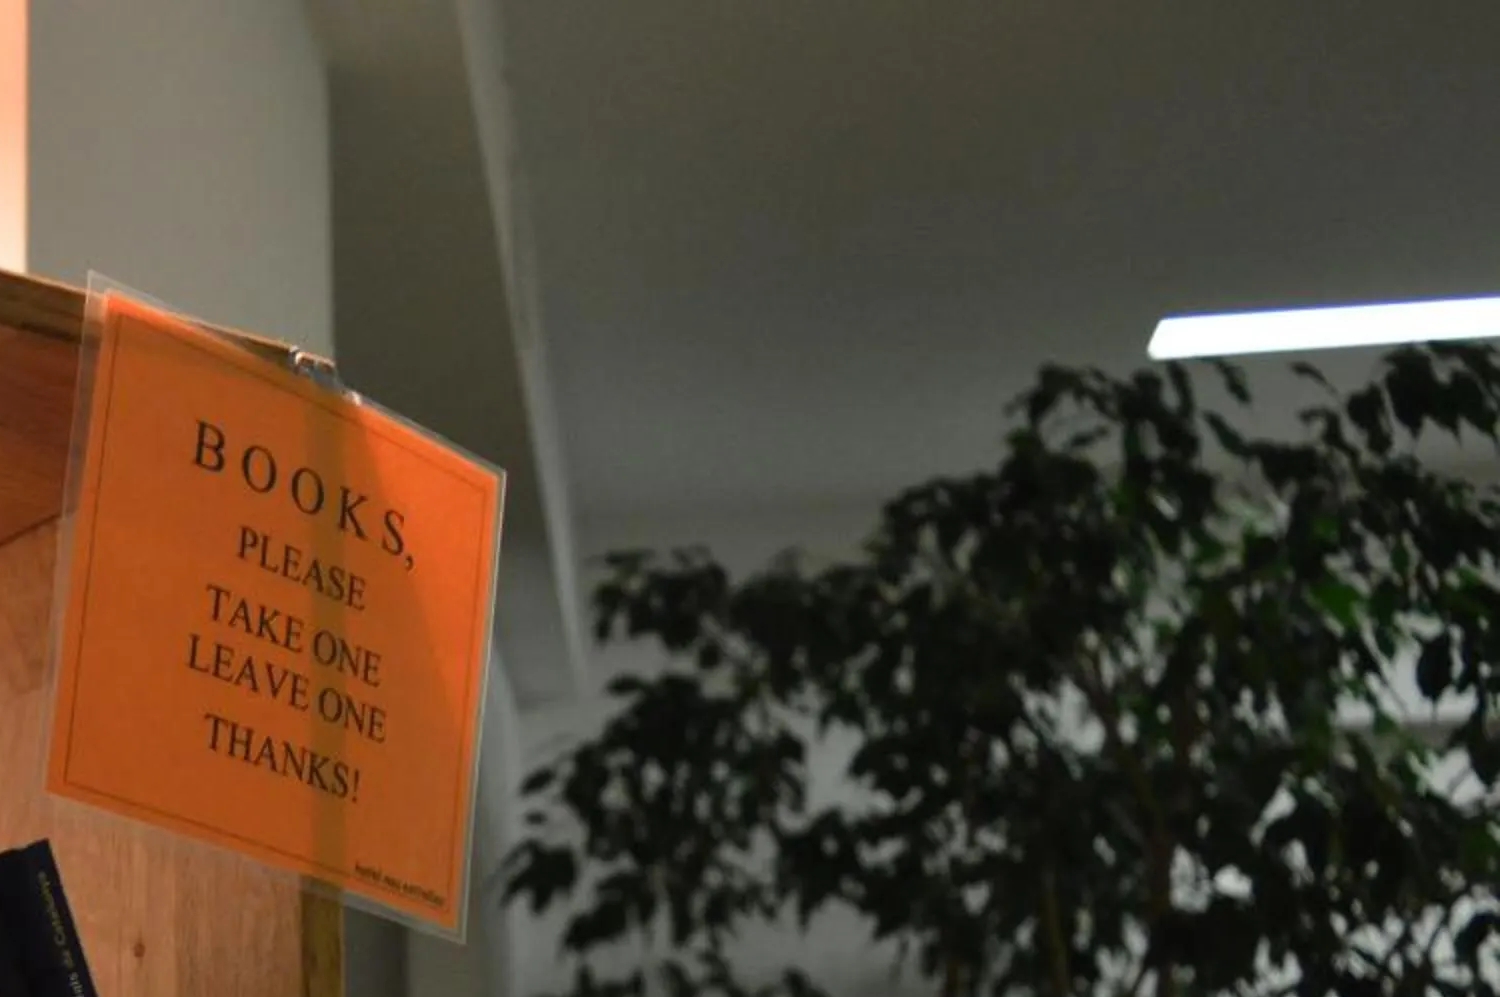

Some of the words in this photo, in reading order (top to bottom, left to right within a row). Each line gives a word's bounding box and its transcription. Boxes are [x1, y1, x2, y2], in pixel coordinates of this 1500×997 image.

[194, 419, 414, 570] BOOKS,
[238, 525, 366, 611] PLEASE
[206, 583, 303, 654] TAKE
[313, 628, 382, 686] ONE
[188, 633, 308, 712] LEAVE
[317, 686, 386, 744] ONE
[203, 711, 361, 802] THANKS!
